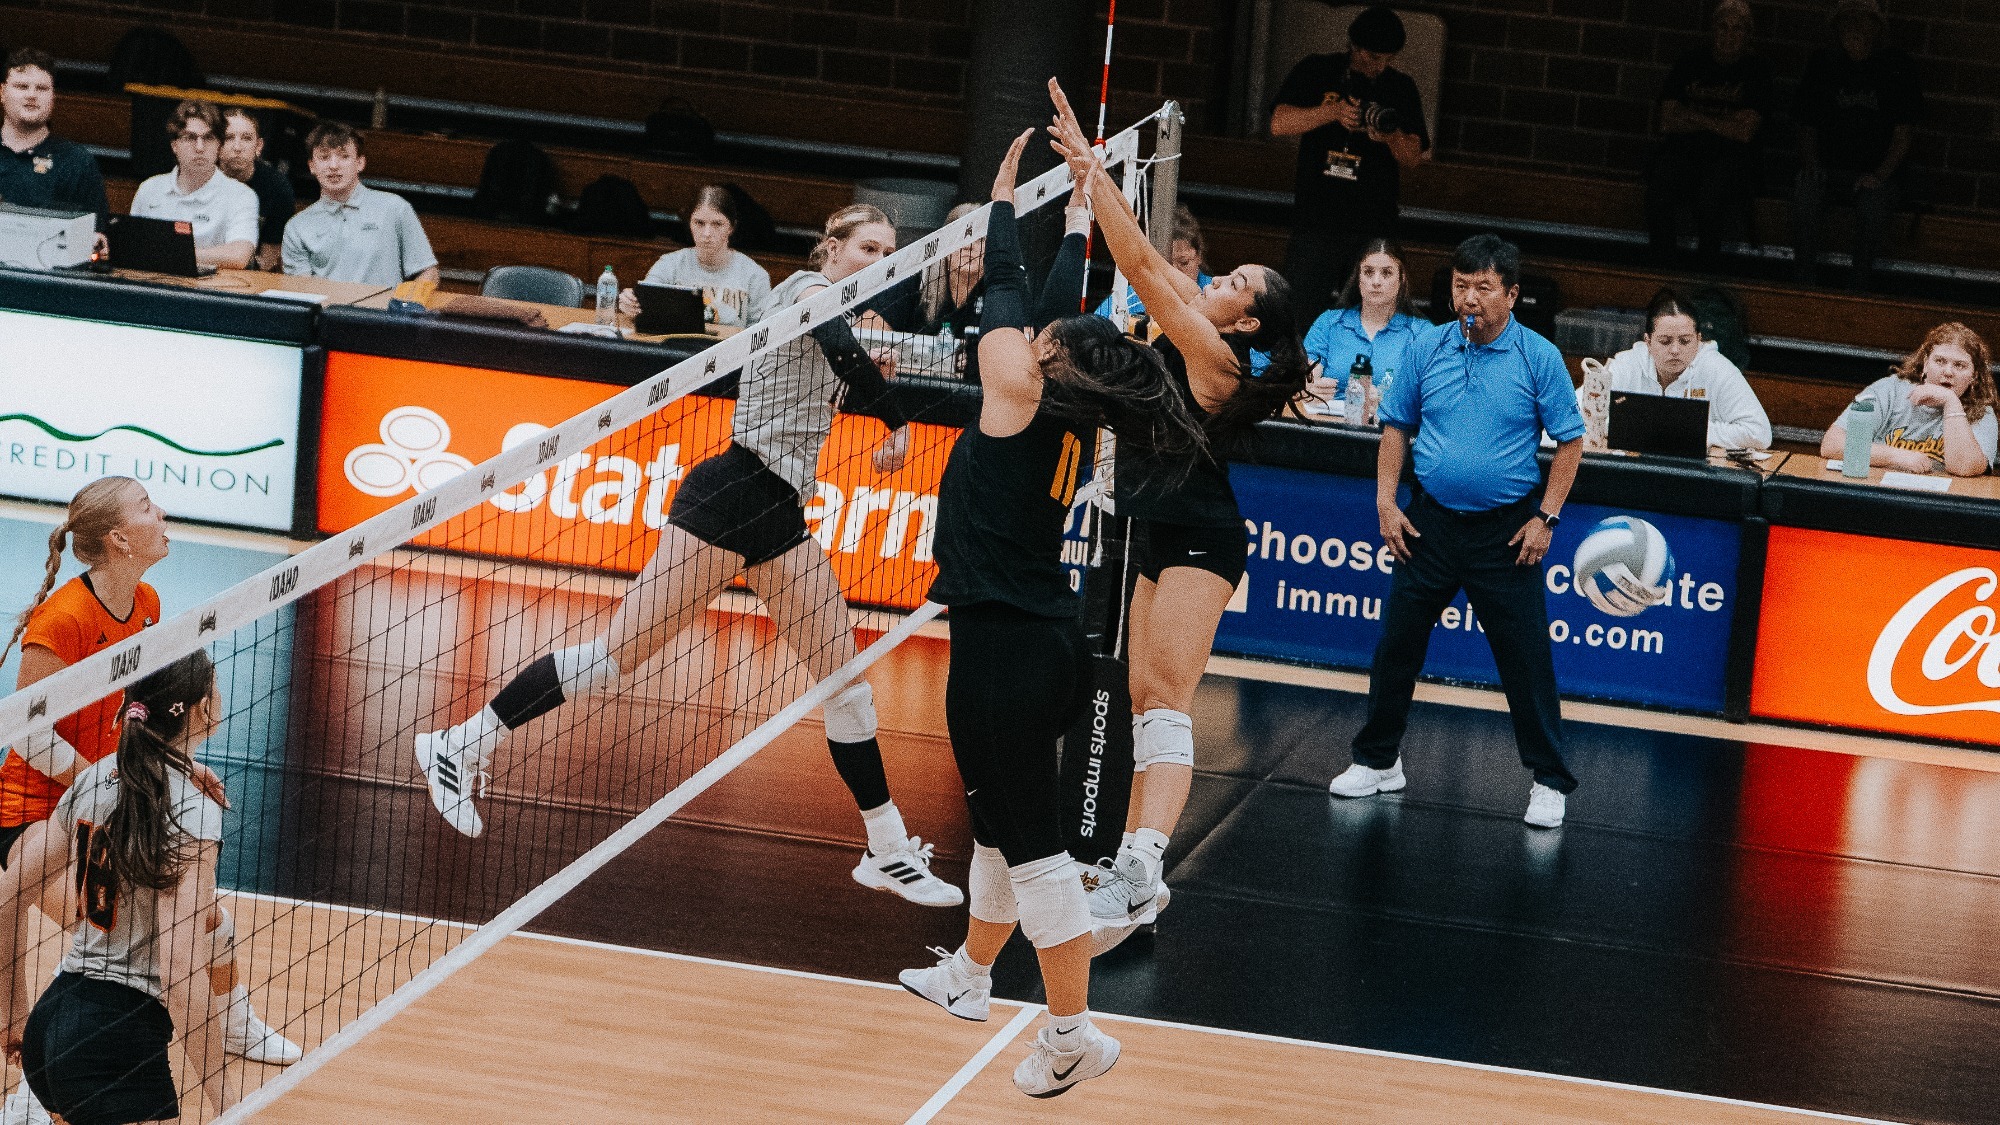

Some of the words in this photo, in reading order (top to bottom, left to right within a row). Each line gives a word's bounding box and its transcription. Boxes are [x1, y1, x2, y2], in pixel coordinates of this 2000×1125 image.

[646, 377, 670, 407] IDAHO
[536, 433, 560, 465] IDAHO
[0, 442, 111, 475] REDIT
[134, 458, 269, 496] UNION
[488, 422, 684, 532] Stat
[803, 480, 938, 562] arm
[410, 496, 437, 531] IDAHO
[269, 565, 299, 602] IDAHO
[109, 644, 141, 684] IDAHO
[1090, 689, 1110, 756] sports
